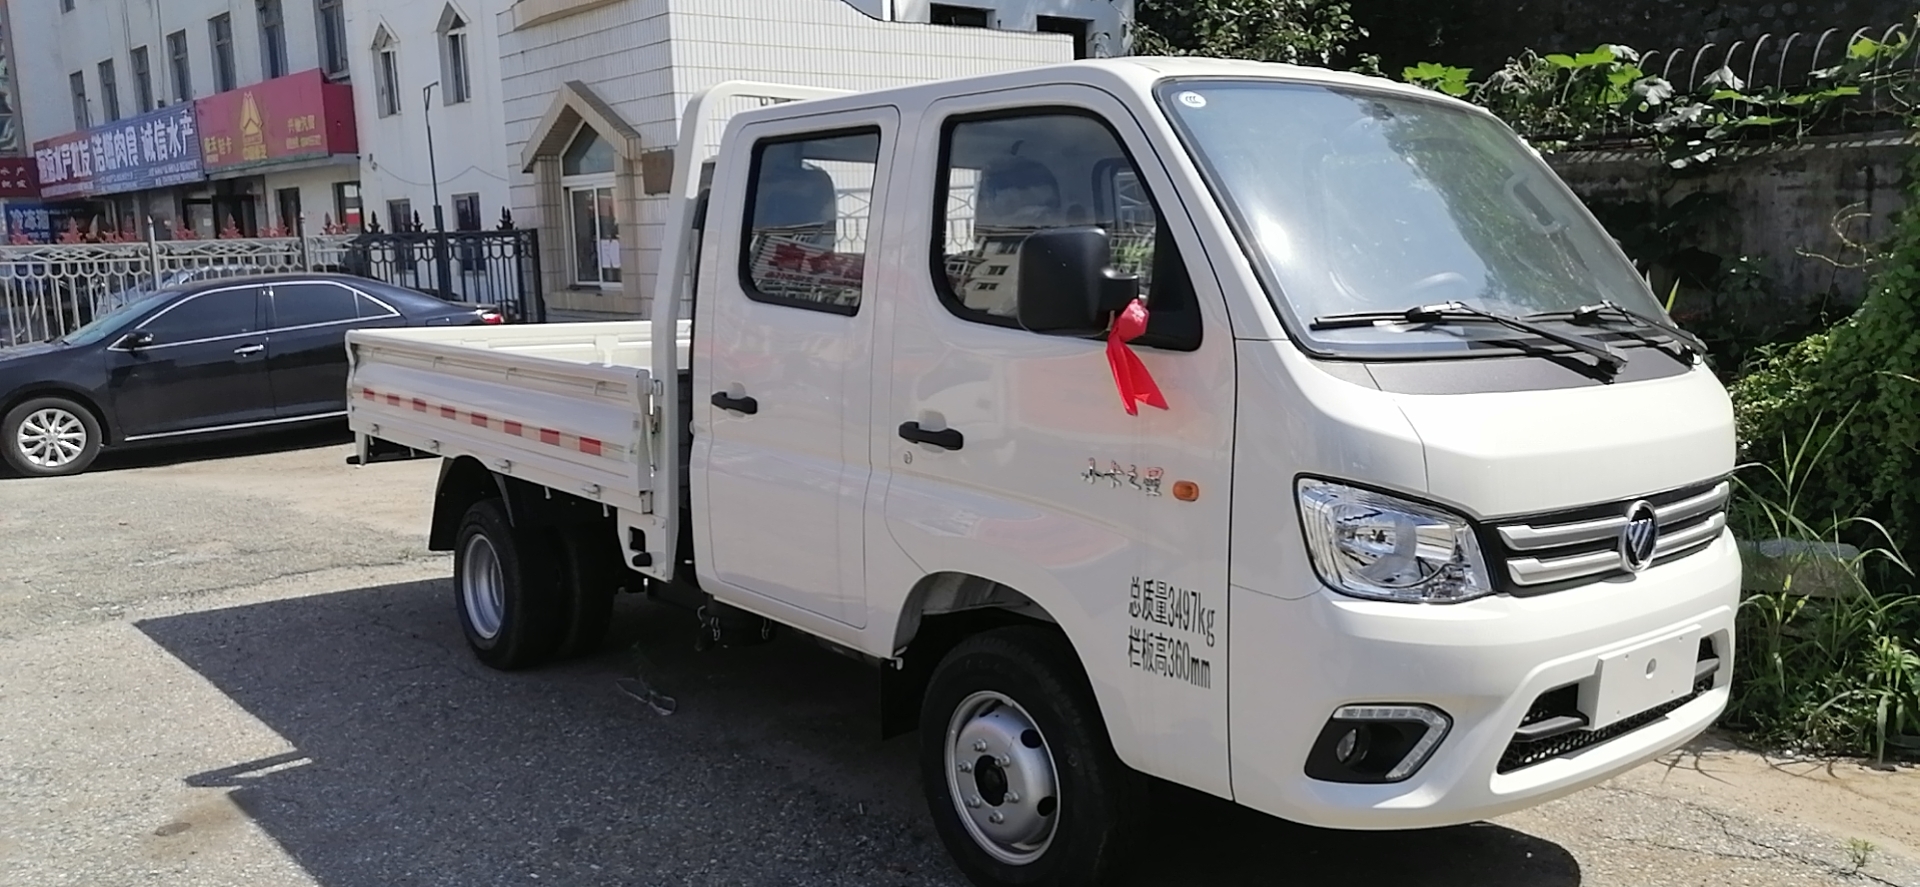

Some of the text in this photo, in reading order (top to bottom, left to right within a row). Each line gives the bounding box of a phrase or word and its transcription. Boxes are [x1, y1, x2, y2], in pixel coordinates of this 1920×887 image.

[140, 109, 194, 162] 诚信水产
[1080, 457, 1165, 497] 小卡之星
[1128, 576, 1215, 648] 总质量3497kg
[1127, 625, 1211, 689] 栏板高360mm
